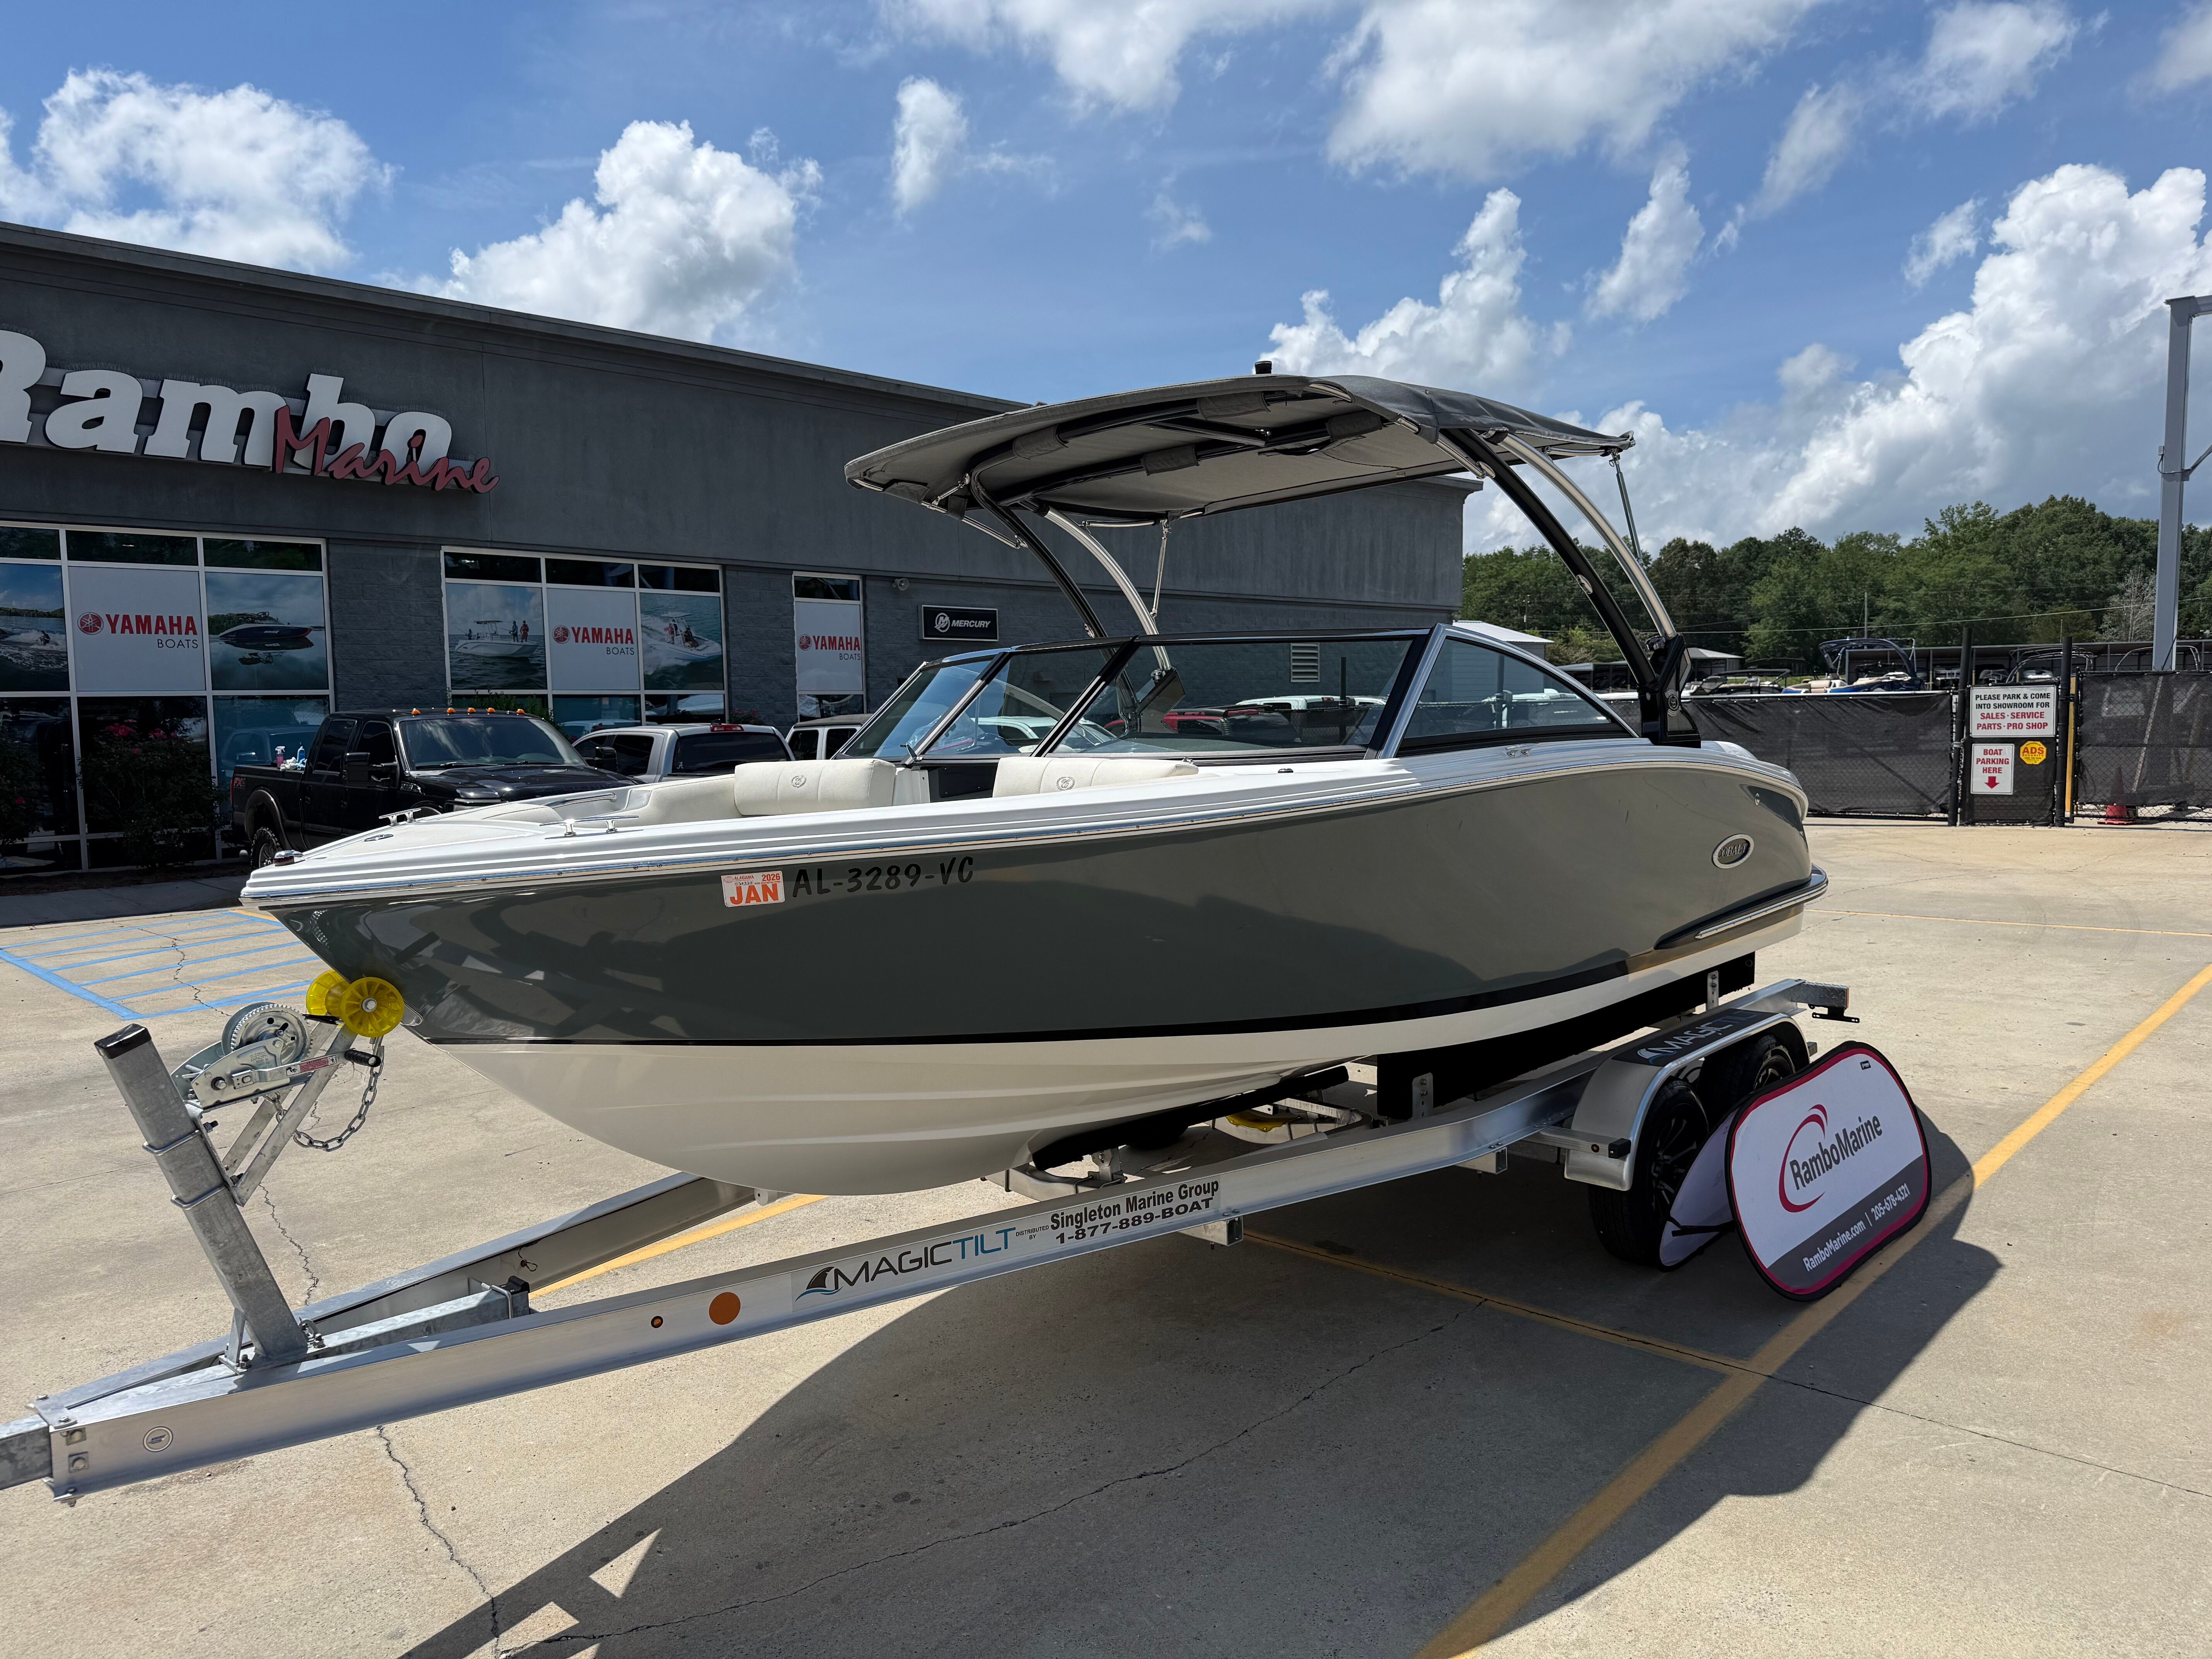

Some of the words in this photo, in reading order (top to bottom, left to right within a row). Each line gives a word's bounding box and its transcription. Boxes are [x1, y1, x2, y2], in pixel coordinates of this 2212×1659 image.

[273, 405, 500, 494] Marine
[105, 614, 198, 635] YAMAHA
[951, 620, 991, 628] MERCURY
[571, 626, 634, 644] YAMAHA
[812, 635, 860, 651] YAMAHA
[157, 639, 198, 649] BOATS
[606, 647, 635, 655] BOATS
[2022, 746, 2044, 754] ADS
[1717, 843, 1748, 859] COBALT
[762, 873, 781, 881] 2026
[730, 883, 779, 905] JAN
[1790, 1116, 1882, 1190] RamboMarine
[1051, 1204, 1121, 1230] Singleton
[1126, 1191, 1174, 1213] Marine
[1178, 1180, 1219, 1200] Group
[1056, 1197, 1214, 1244] 1-877-889-BOAT
[1803, 1220, 1866, 1272] RamboMarine.com
[1871, 1183, 1910, 1221] 205-678-4321
[1016, 1225, 1049, 1237] DISTRIBUTED
